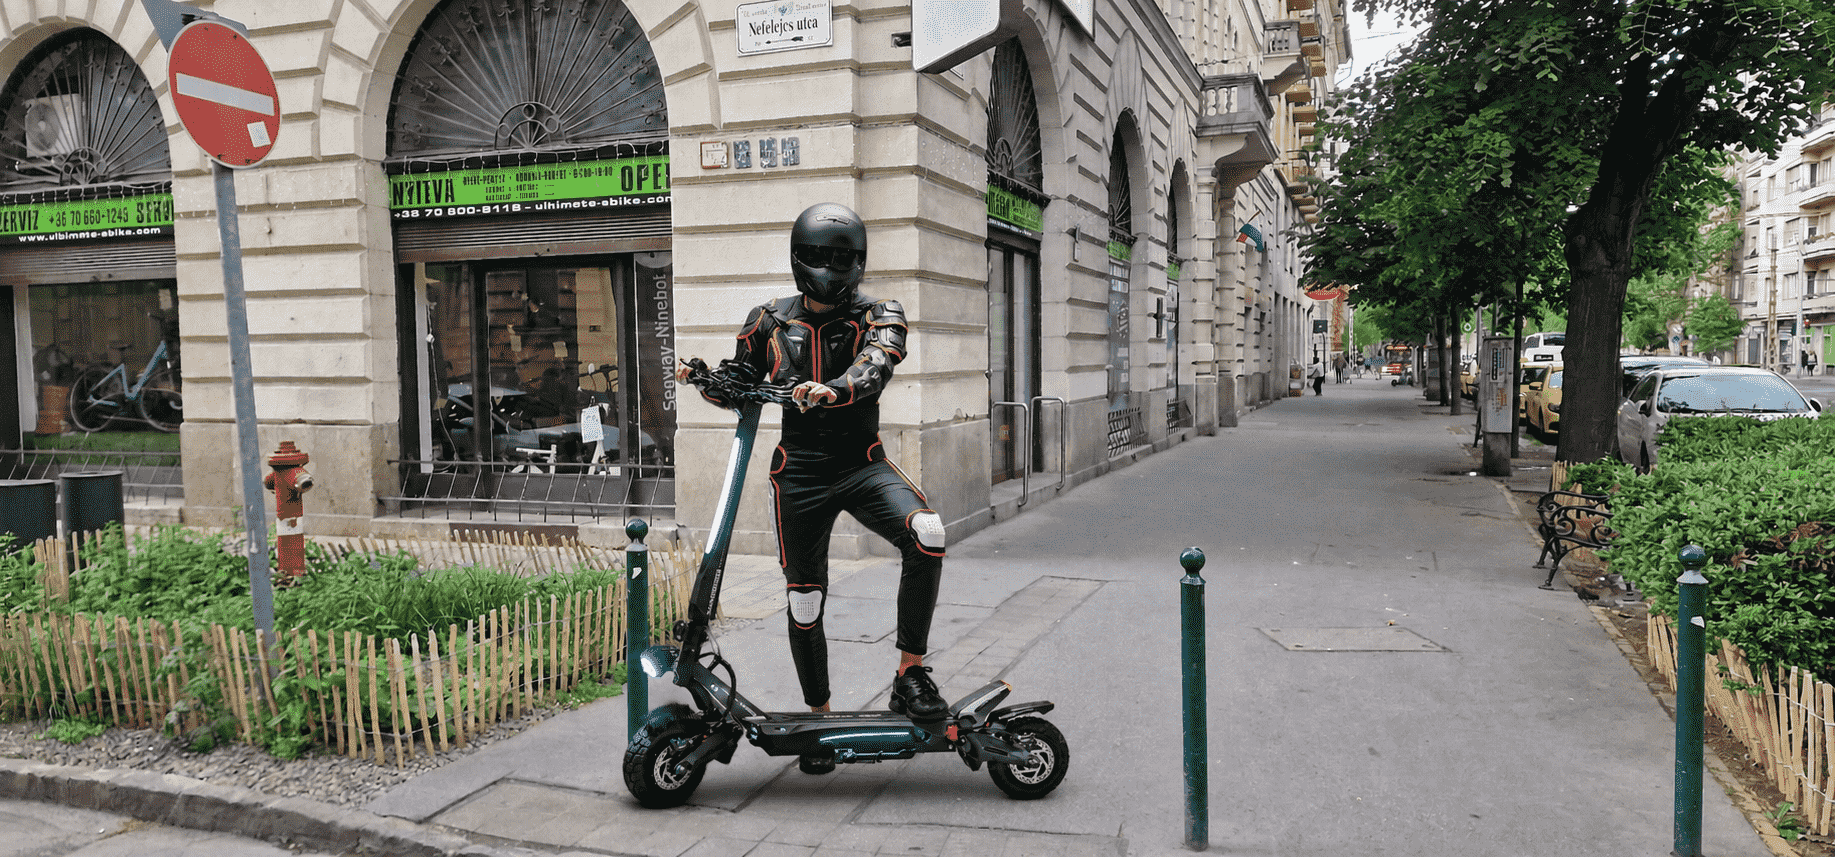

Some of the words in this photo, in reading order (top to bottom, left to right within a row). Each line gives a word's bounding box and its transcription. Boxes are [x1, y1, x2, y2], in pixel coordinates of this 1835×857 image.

[749, 18, 794, 37] Nefelejcs
[797, 17, 819, 31] utca
[70, 210, 81, 226] 70
[425, 208, 443, 217] 70
